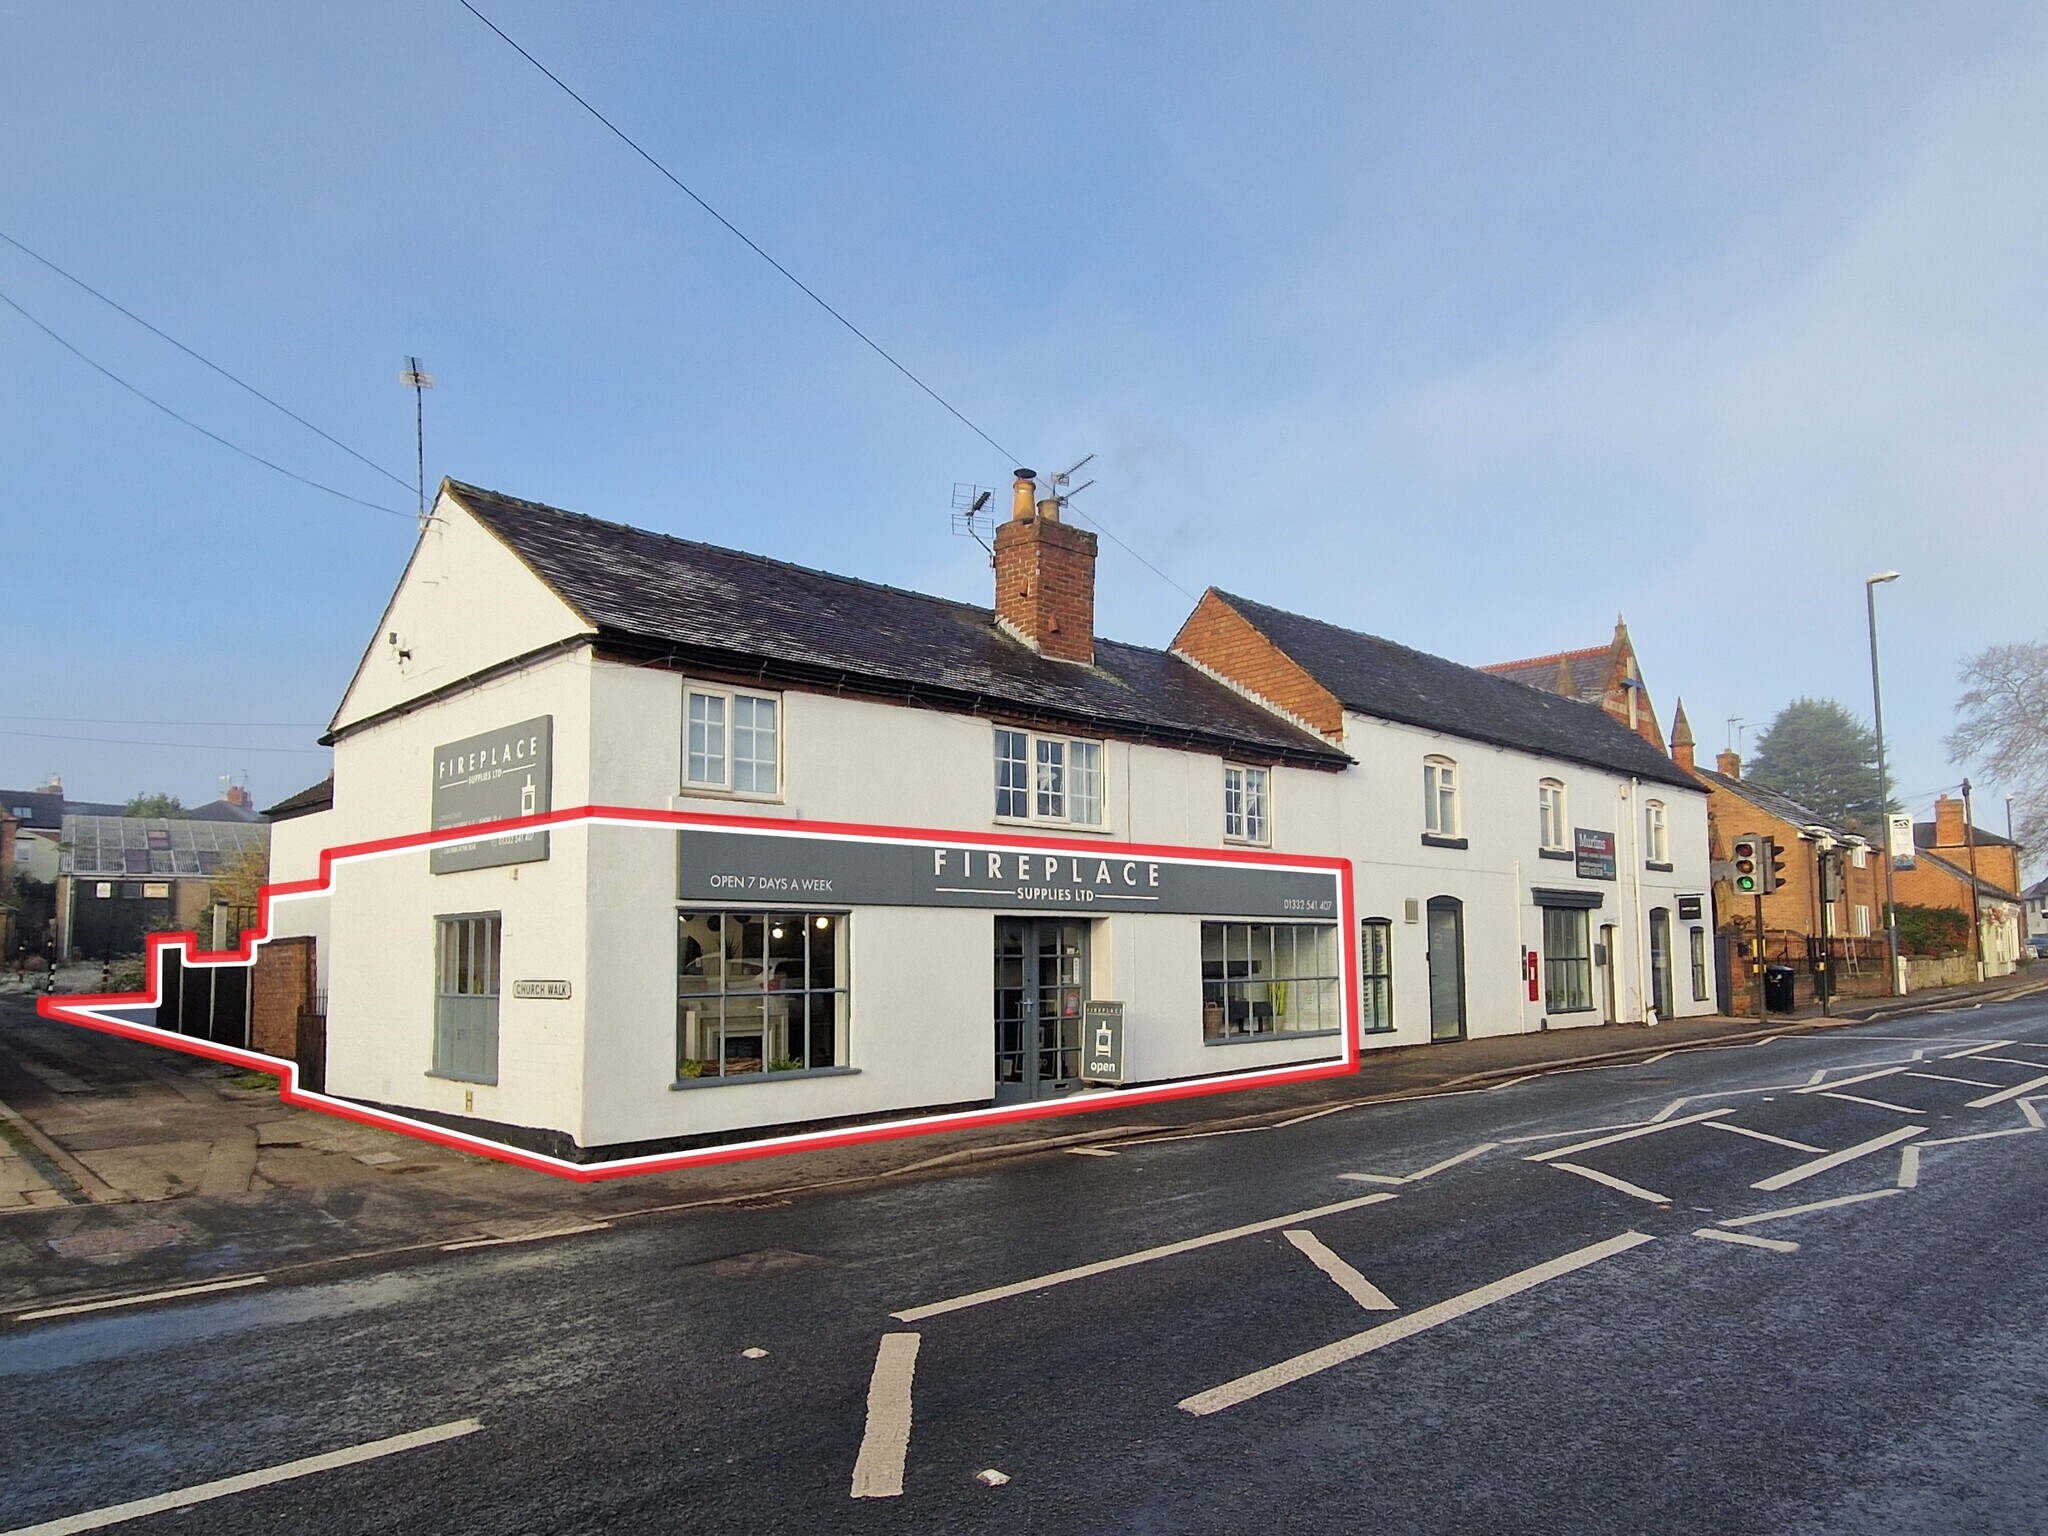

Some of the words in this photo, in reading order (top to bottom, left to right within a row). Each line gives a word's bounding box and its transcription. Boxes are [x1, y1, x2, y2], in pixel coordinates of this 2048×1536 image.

[440, 736, 537, 779] FIREPLACE
[468, 770, 492, 785] SUPPLIES
[492, 768, 502, 779] LTD
[934, 849, 1159, 887] FIREPLACE
[710, 874, 745, 888] OPEN
[748, 876, 756, 889] 7
[759, 877, 788, 890] DAYS
[790, 878, 799, 890] A
[801, 879, 833, 892] WEEK
[1017, 887, 1071, 901] SUPPLIES
[1075, 889, 1094, 902] LTD
[1283, 899, 1304, 910] 01332
[1306, 900, 1318, 910] 541
[1319, 900, 1332, 911] 407
[516, 984, 546, 996] CHURCH
[547, 984, 567, 996] WALK
[1090, 1061, 1116, 1074] open
